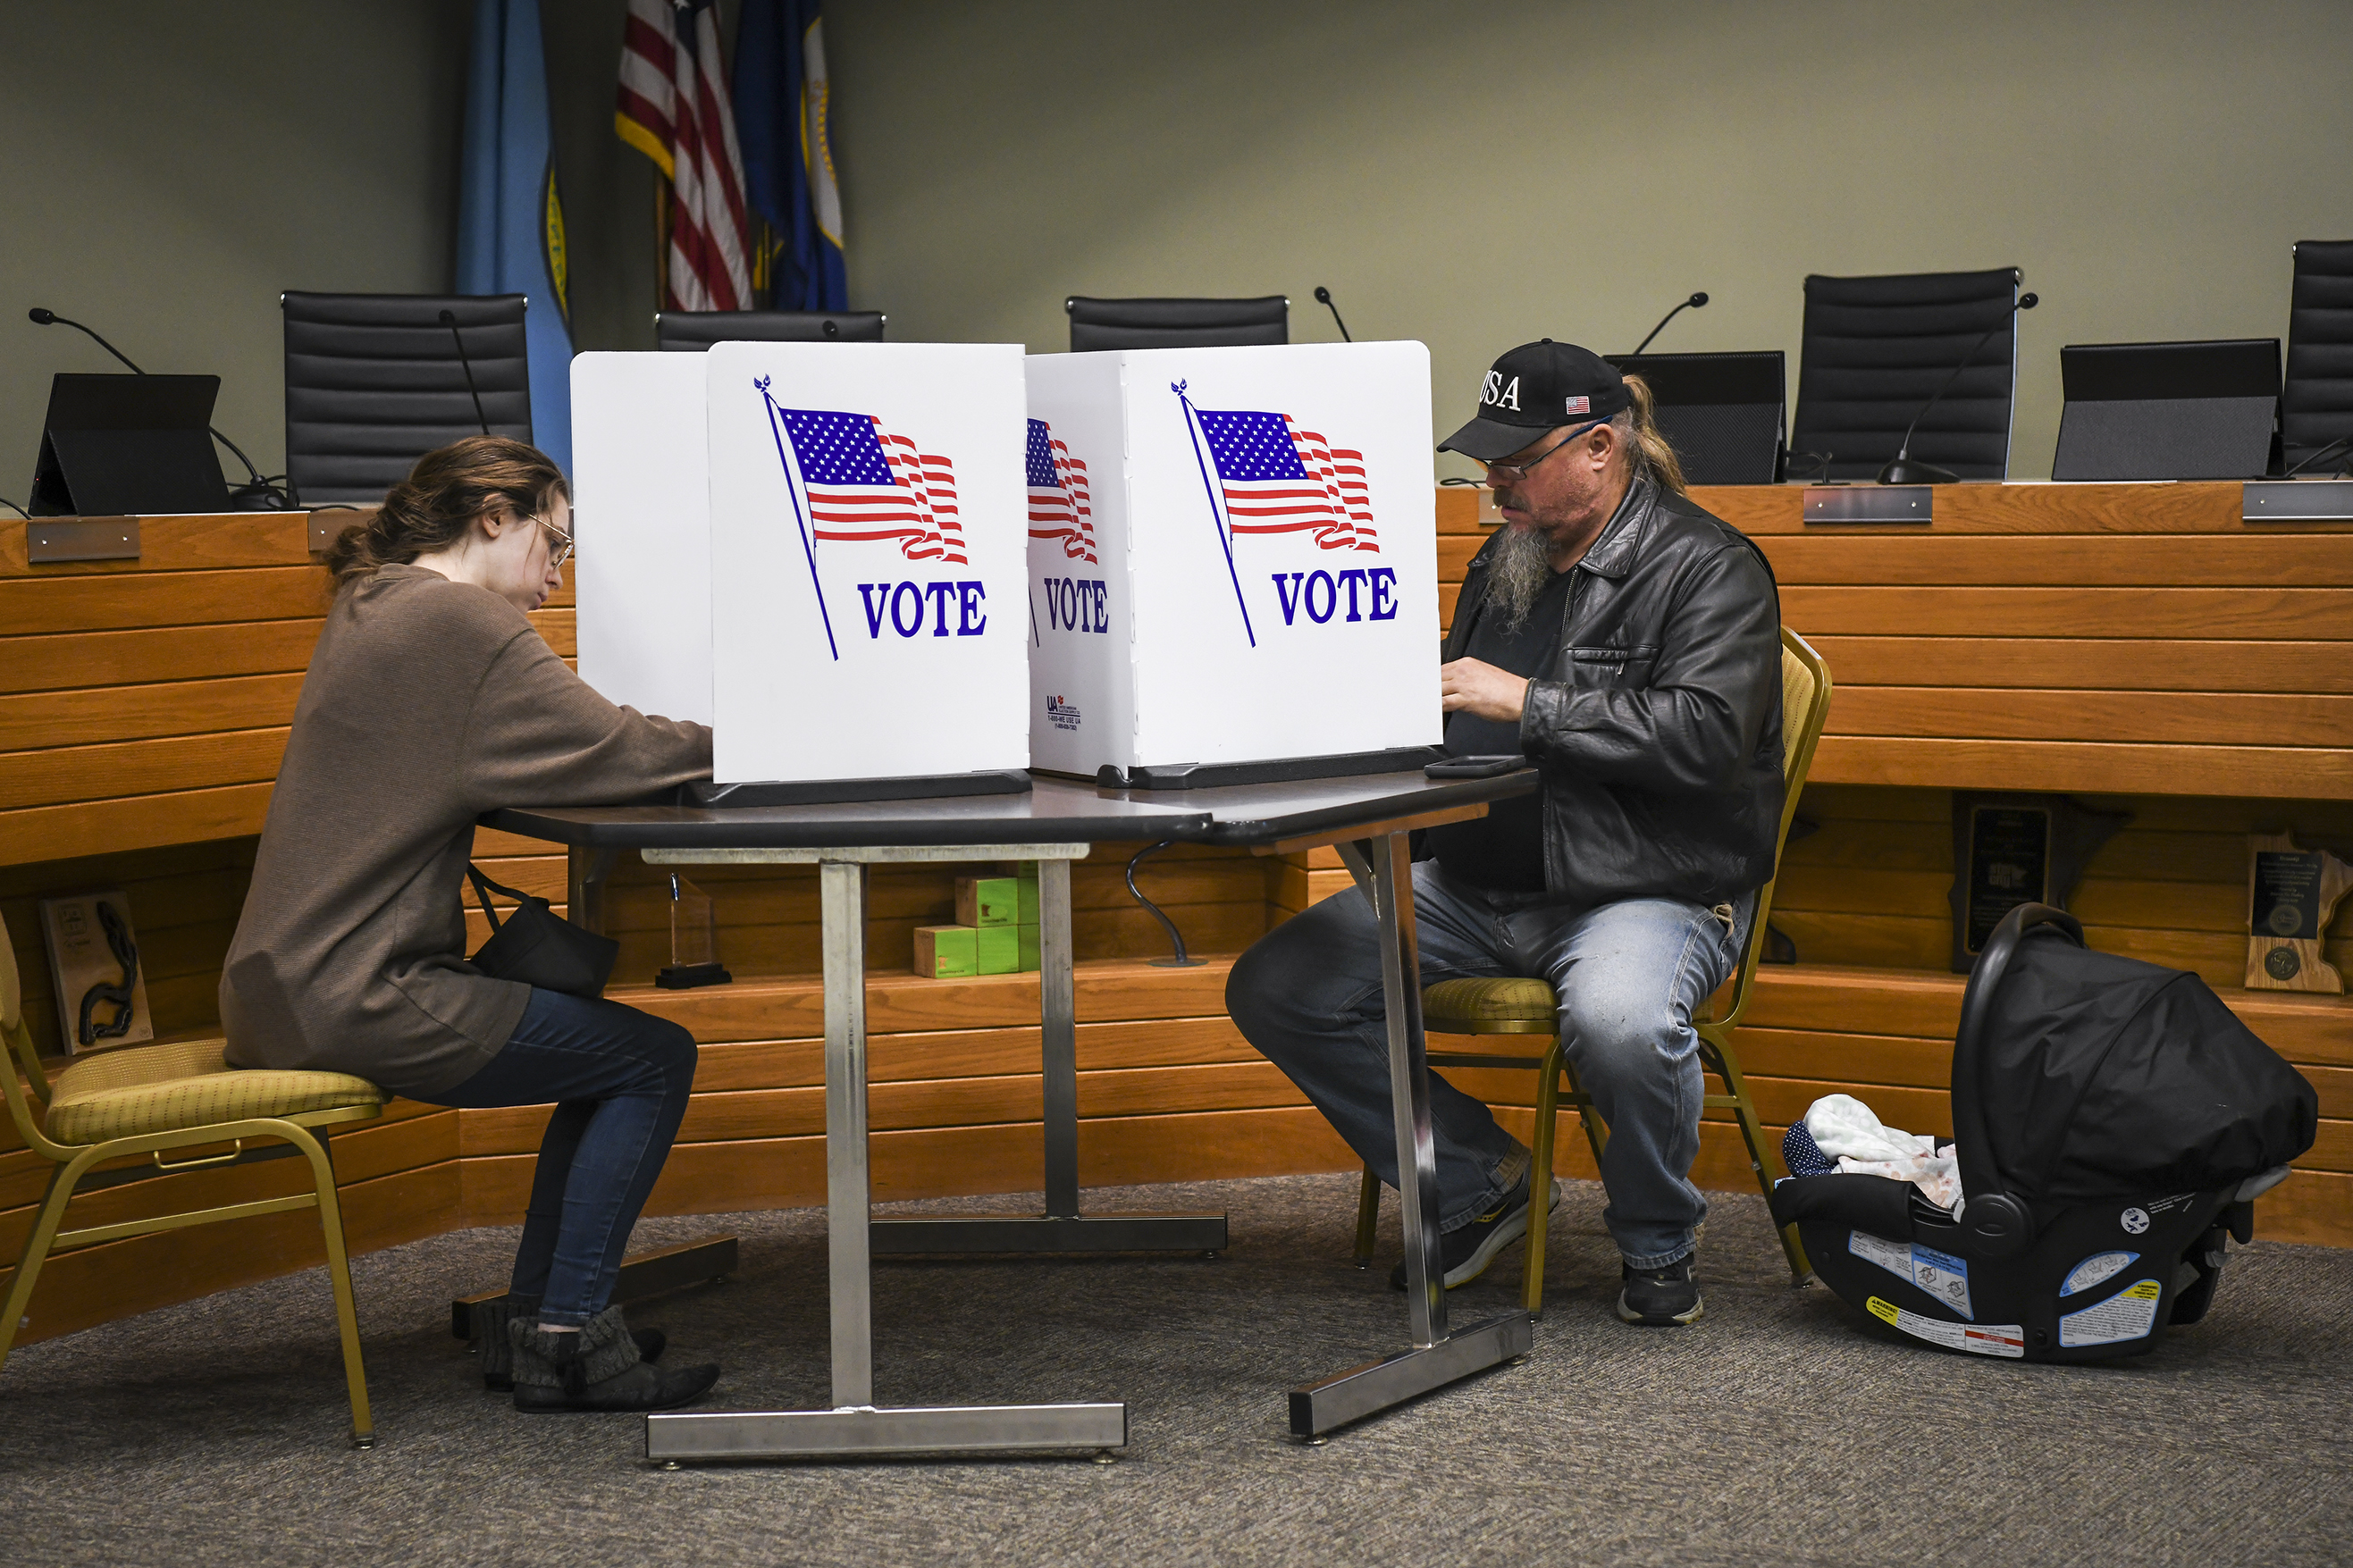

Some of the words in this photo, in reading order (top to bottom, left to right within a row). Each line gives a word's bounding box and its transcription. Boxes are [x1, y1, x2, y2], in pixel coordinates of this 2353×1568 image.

[1479, 367, 1521, 412] USA
[858, 581, 987, 640] VOTE
[1045, 577, 1109, 634] VOTE
[1272, 567, 1399, 626] VOTE
[1046, 695, 1058, 712] UA
